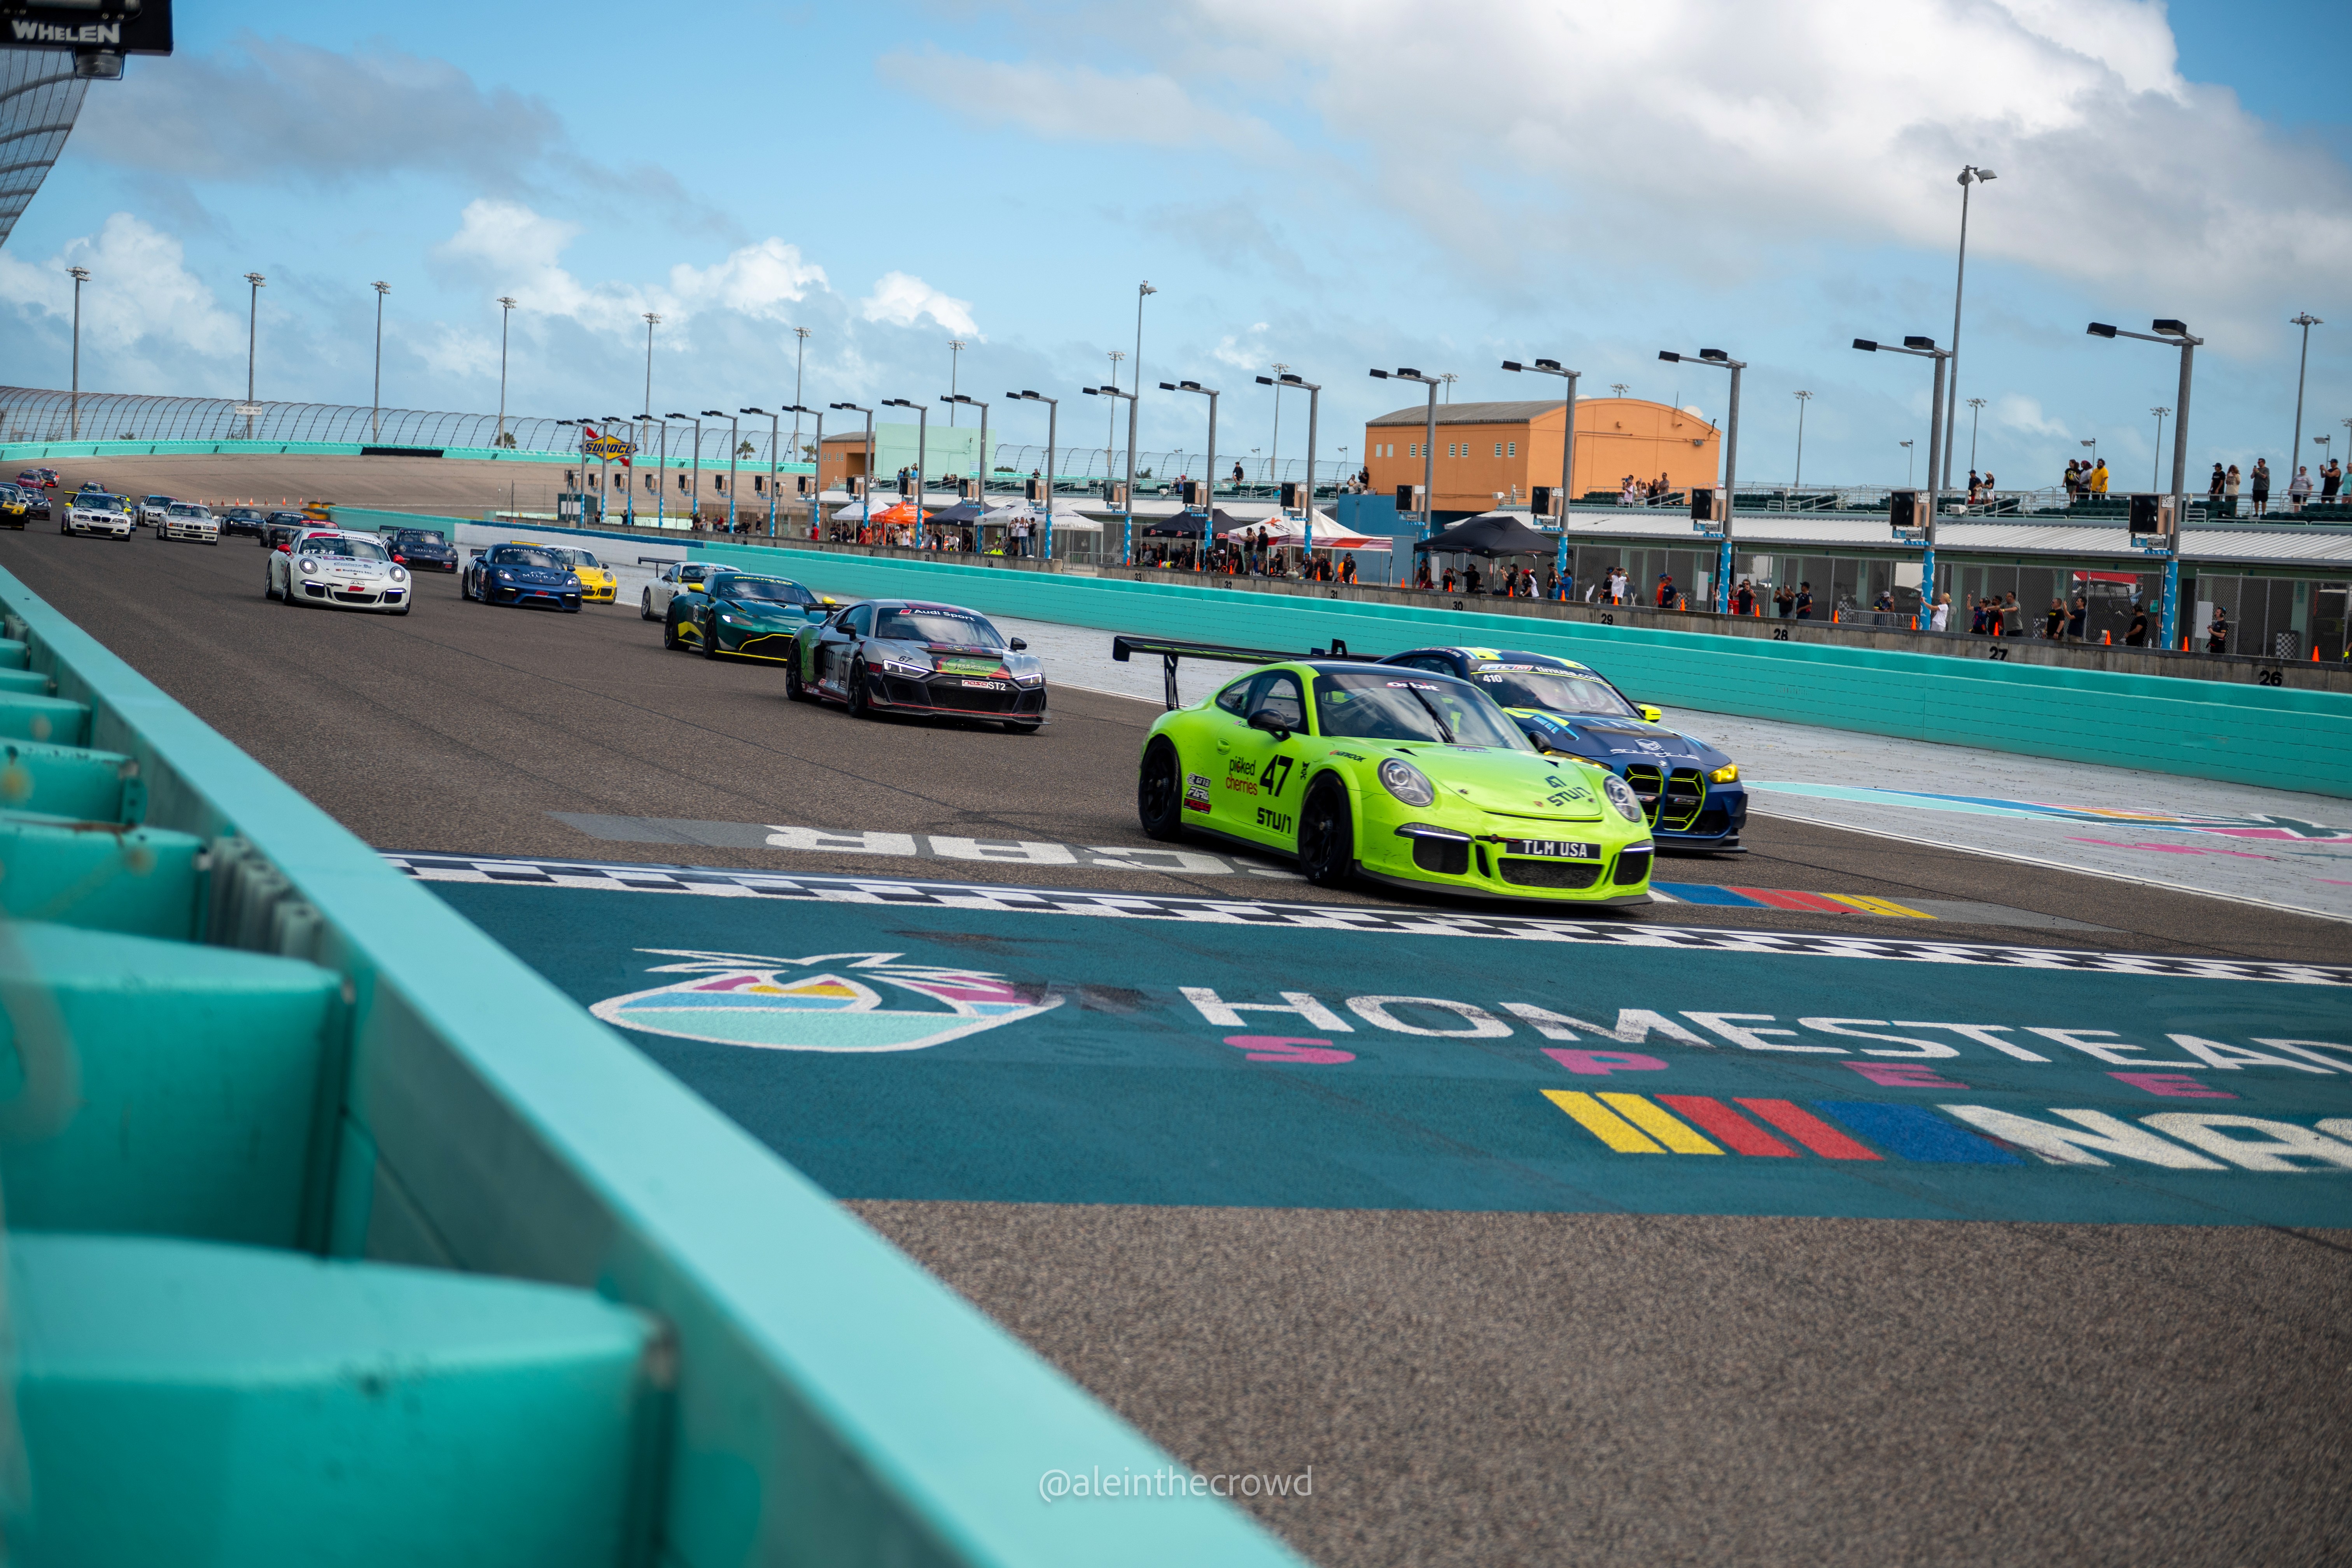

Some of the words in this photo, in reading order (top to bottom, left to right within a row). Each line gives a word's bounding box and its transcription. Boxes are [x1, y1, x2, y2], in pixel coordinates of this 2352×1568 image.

[11, 20, 120, 43] WHELEN
[339, 535, 375, 543] MOTORSPORT
[987, 559, 993, 568] 34
[1134, 573, 1142, 581] 33
[1224, 580, 1232, 589] 32
[1330, 590, 1338, 599] 31
[1452, 600, 1463, 611] 30
[942, 611, 975, 621] Sport
[1601, 613, 1614, 625] 29
[1773, 628, 1788, 641] 28
[1989, 646, 2008, 661] 27
[945, 658, 988, 671] Garza
[1482, 674, 1503, 683] 410
[1535, 666, 1604, 683] tlmusa.com
[2259, 670, 2282, 686] 26
[988, 681, 1006, 691] ST2
[1229, 756, 1256, 776] picked
[1260, 754, 1295, 797] 47
[1544, 775, 1567, 789] 47
[1225, 774, 1258, 796] cherries
[1522, 840, 1555, 856] TLM
[1559, 841, 1588, 858] USA
